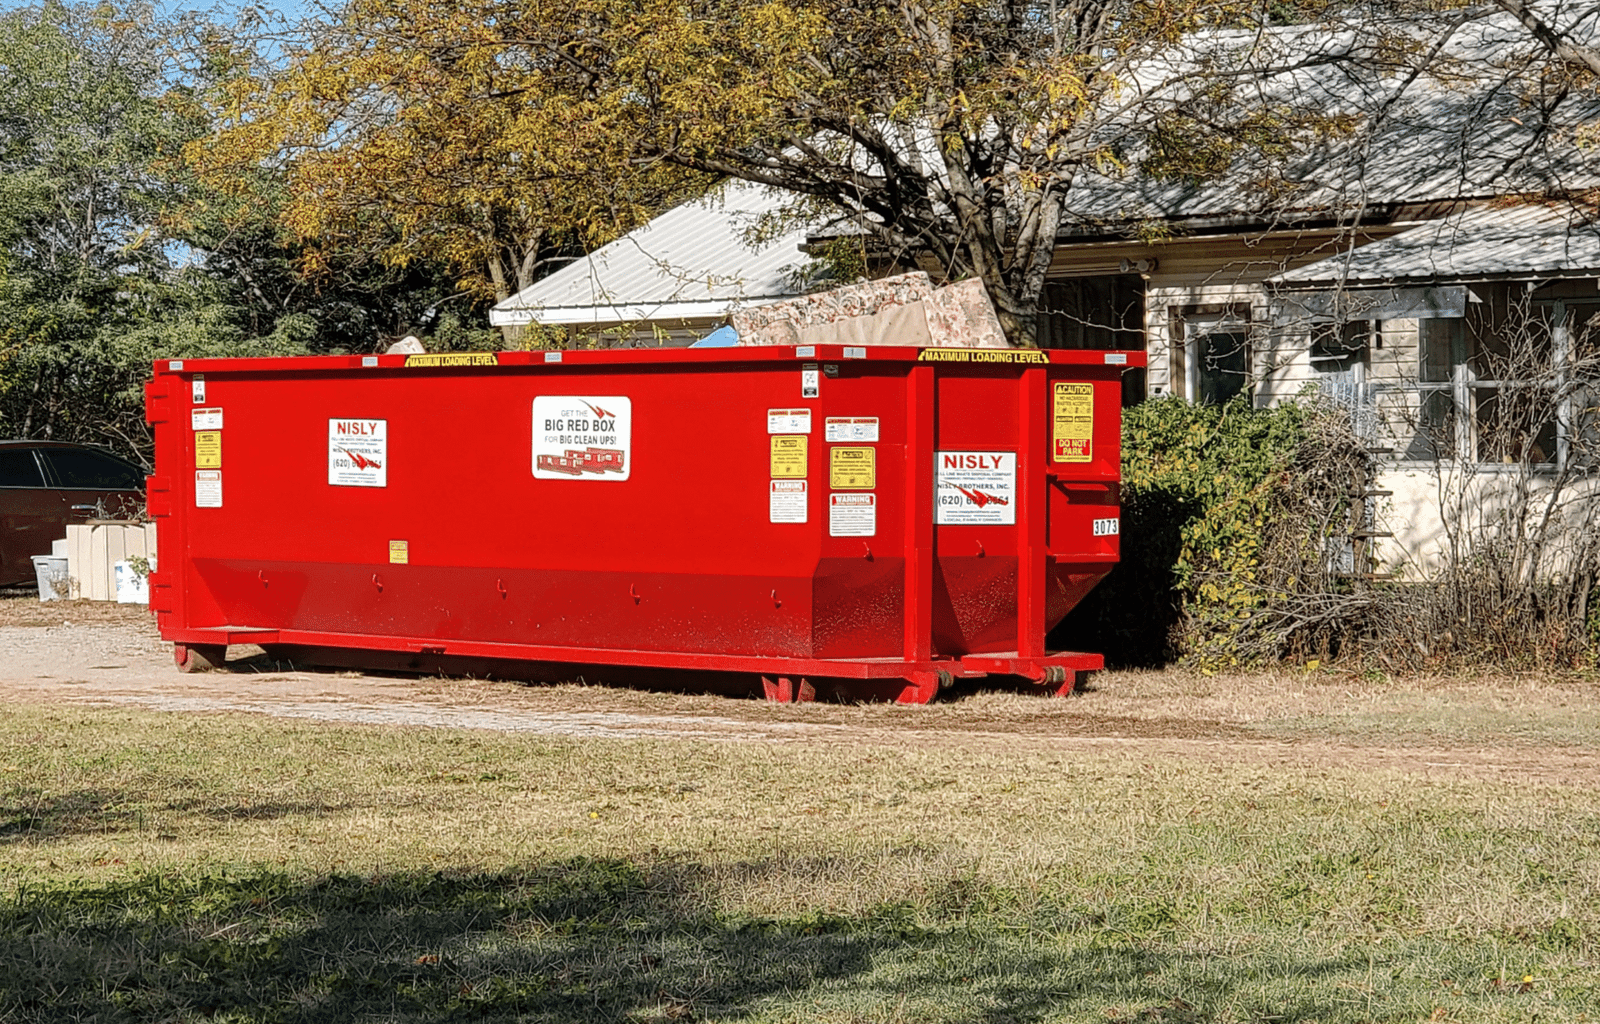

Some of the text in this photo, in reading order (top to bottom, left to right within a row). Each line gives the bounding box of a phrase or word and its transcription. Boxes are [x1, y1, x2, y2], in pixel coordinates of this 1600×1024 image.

[410, 356, 493, 367] MAXIMUM LOADING LEVEL
[926, 351, 1043, 363] MAXIMUM LOADING LEVEL
[1062, 385, 1091, 394] CAUTION
[337, 422, 377, 435] NISLY
[545, 419, 615, 432] BIG RED BOX
[560, 435, 572, 444] BIG
[574, 435, 597, 445] CLEAN
[599, 436, 617, 445] UPS!
[1058, 439, 1087, 447] DO NOT
[1063, 447, 1083, 456] PARK
[333, 459, 350, 469] (620)
[944, 455, 1003, 469] NISLY
[835, 495, 871, 503] WARNING
[938, 495, 963, 507] (620)
[1095, 519, 1117, 534] 3073
